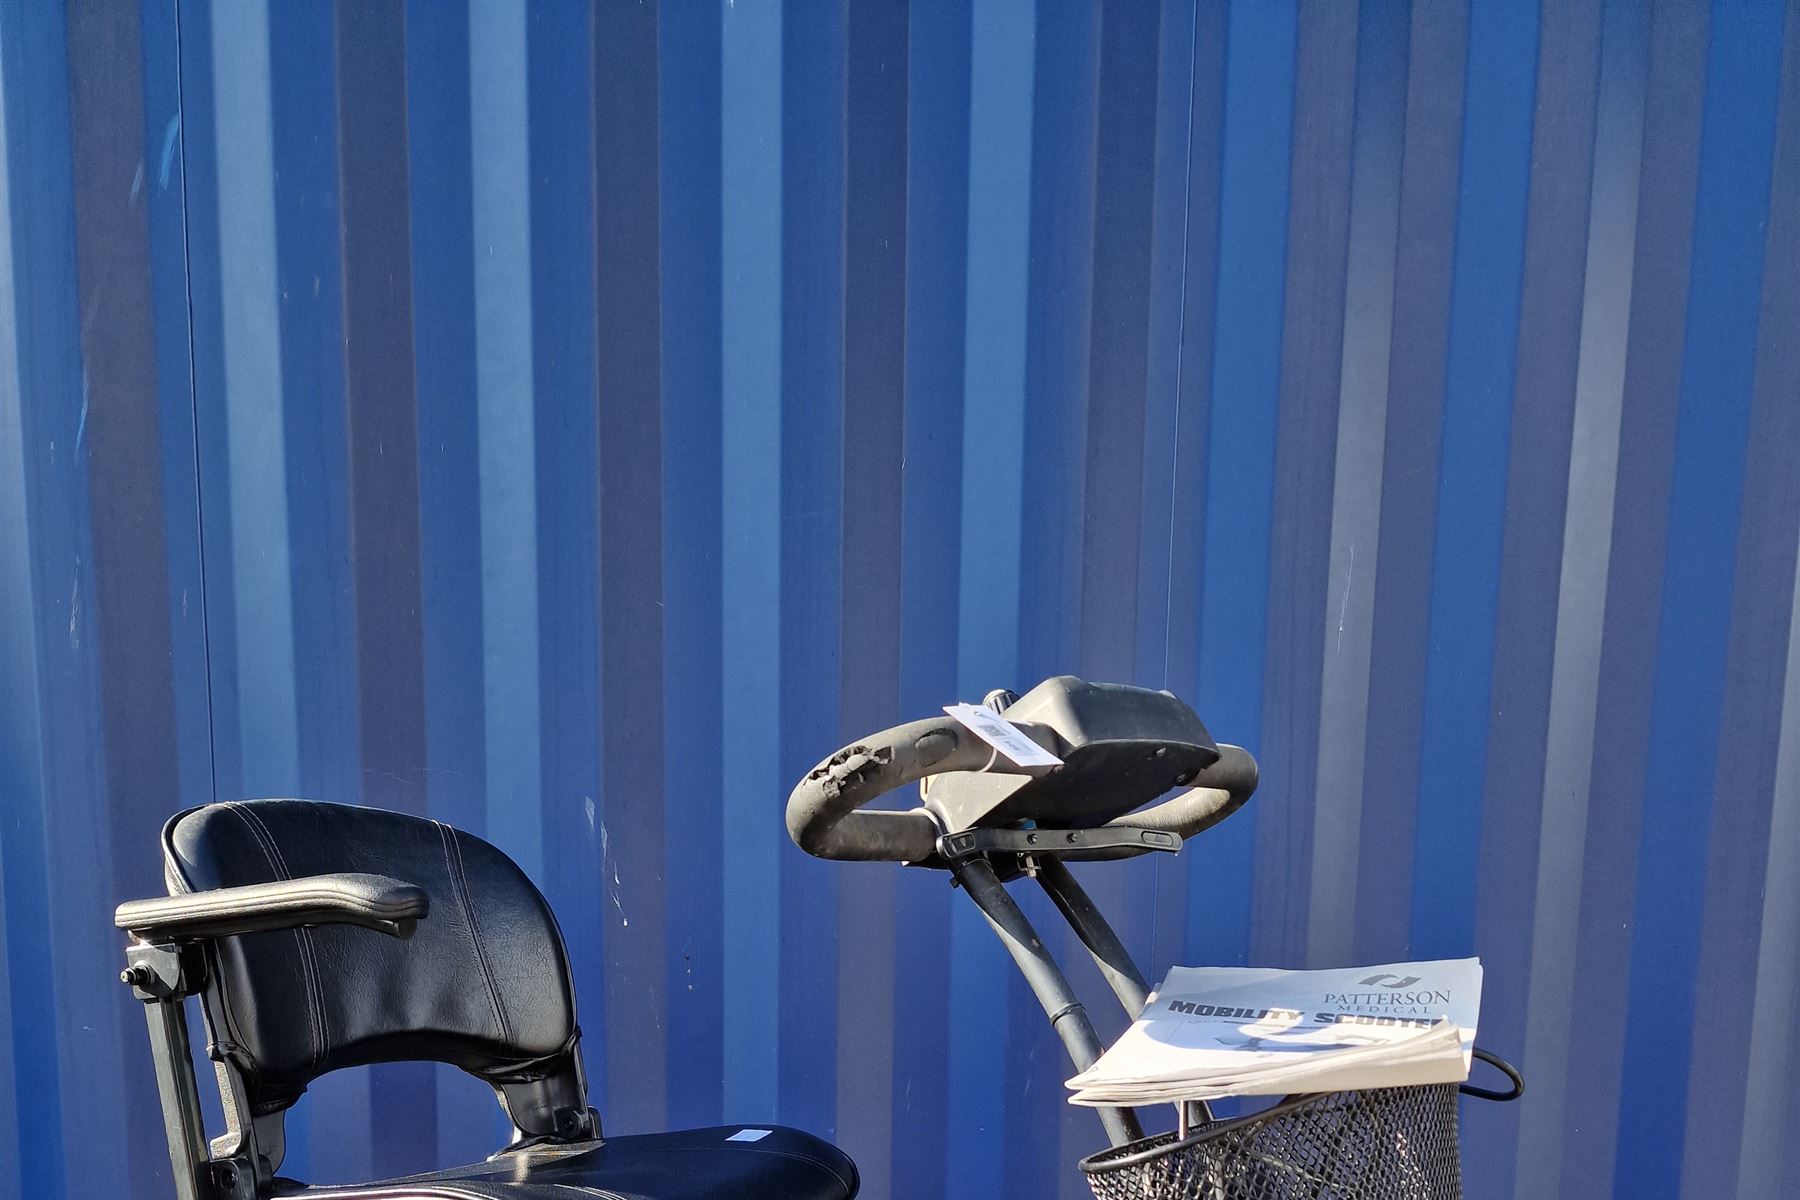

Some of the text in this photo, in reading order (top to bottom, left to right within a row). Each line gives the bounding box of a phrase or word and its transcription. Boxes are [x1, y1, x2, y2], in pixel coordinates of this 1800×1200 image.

[1324, 990, 1451, 1005] PATTERSON
[1168, 1000, 1306, 1020] MOBILITY
[1338, 1005, 1432, 1014] MEDICAL
